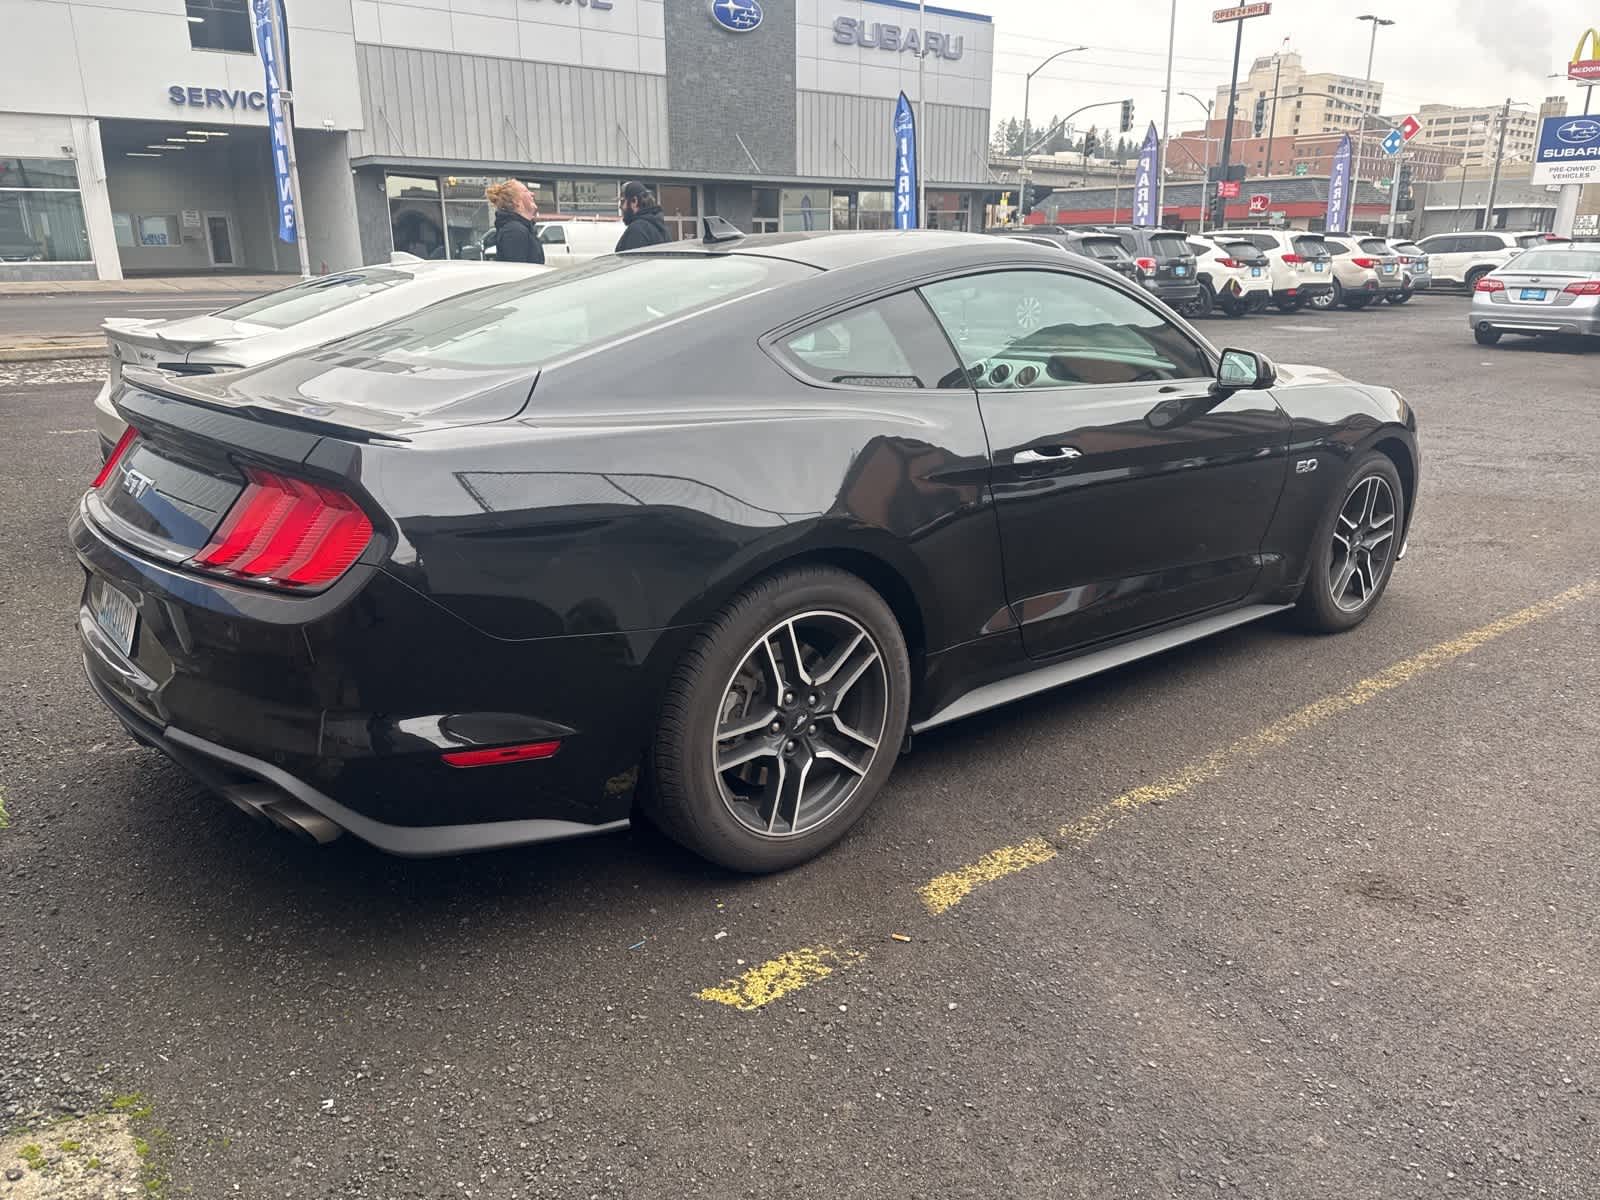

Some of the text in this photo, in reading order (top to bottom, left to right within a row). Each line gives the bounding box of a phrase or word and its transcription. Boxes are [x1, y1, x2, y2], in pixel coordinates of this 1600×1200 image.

[832, 15, 963, 60] SUBARU
[168, 85, 266, 111] SERVIC
[1549, 165, 1596, 173] PRE-OWNED
